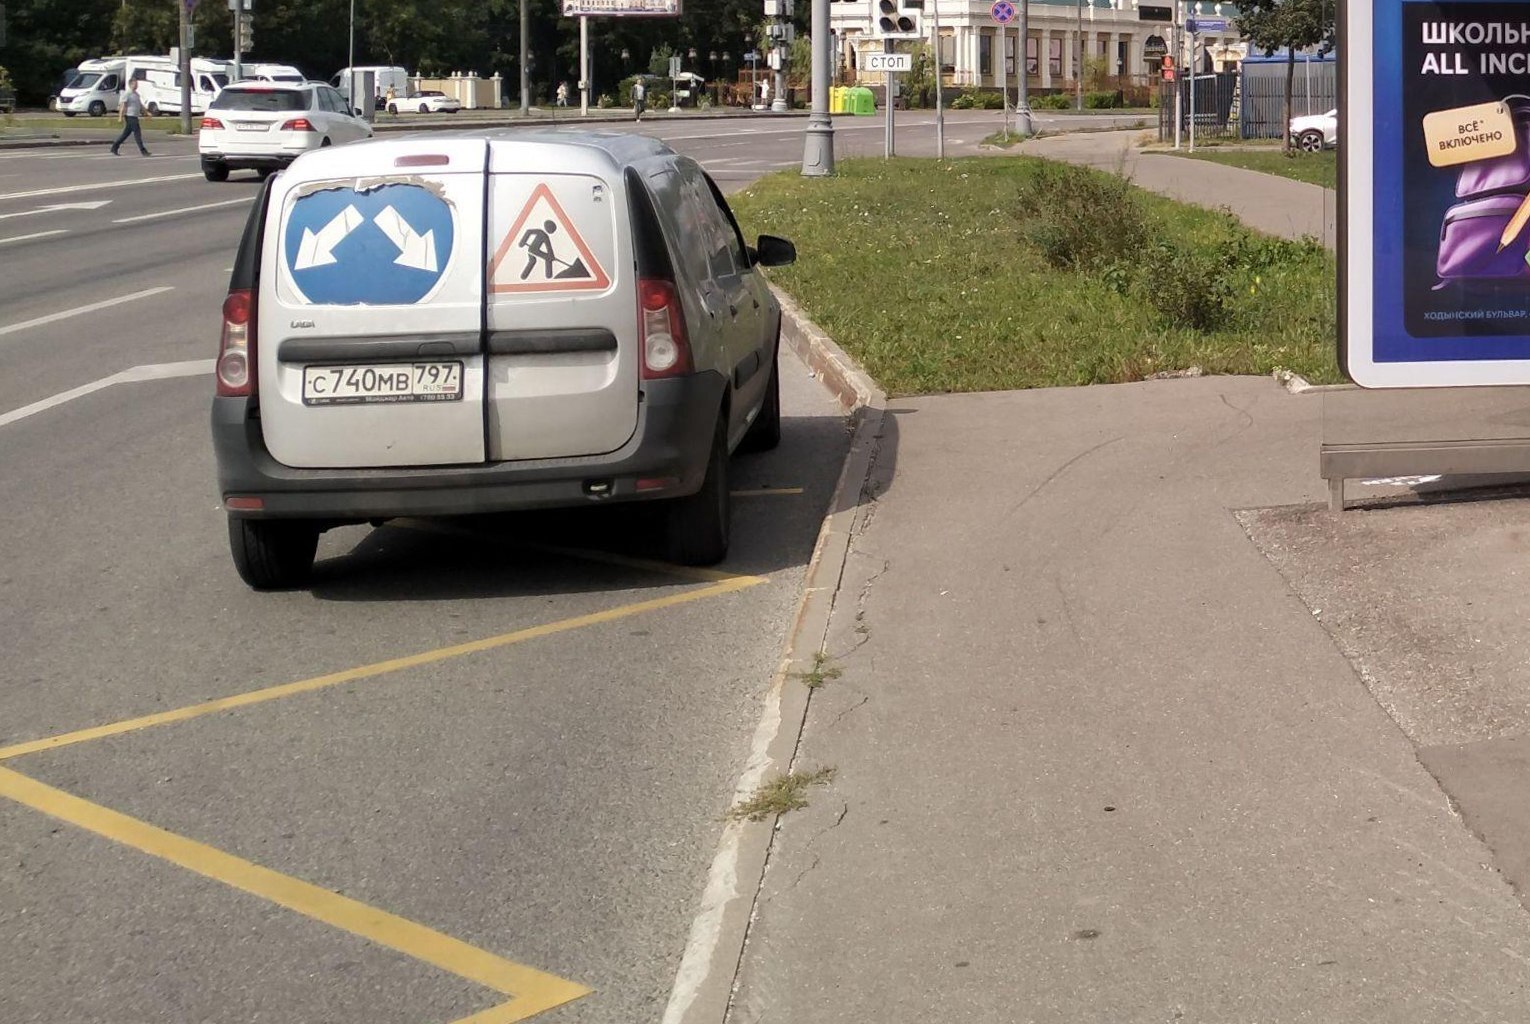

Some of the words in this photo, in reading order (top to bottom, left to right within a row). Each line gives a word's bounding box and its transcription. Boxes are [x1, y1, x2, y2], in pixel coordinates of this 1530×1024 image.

[871, 56, 904, 68] СТОП
[1420, 52, 1469, 75] ALL
[1438, 131, 1503, 151] ВКЛЮЧЕНО
[1423, 309, 1485, 321] ХОДЫНСКИЙ
[414, 364, 454, 384] 797
